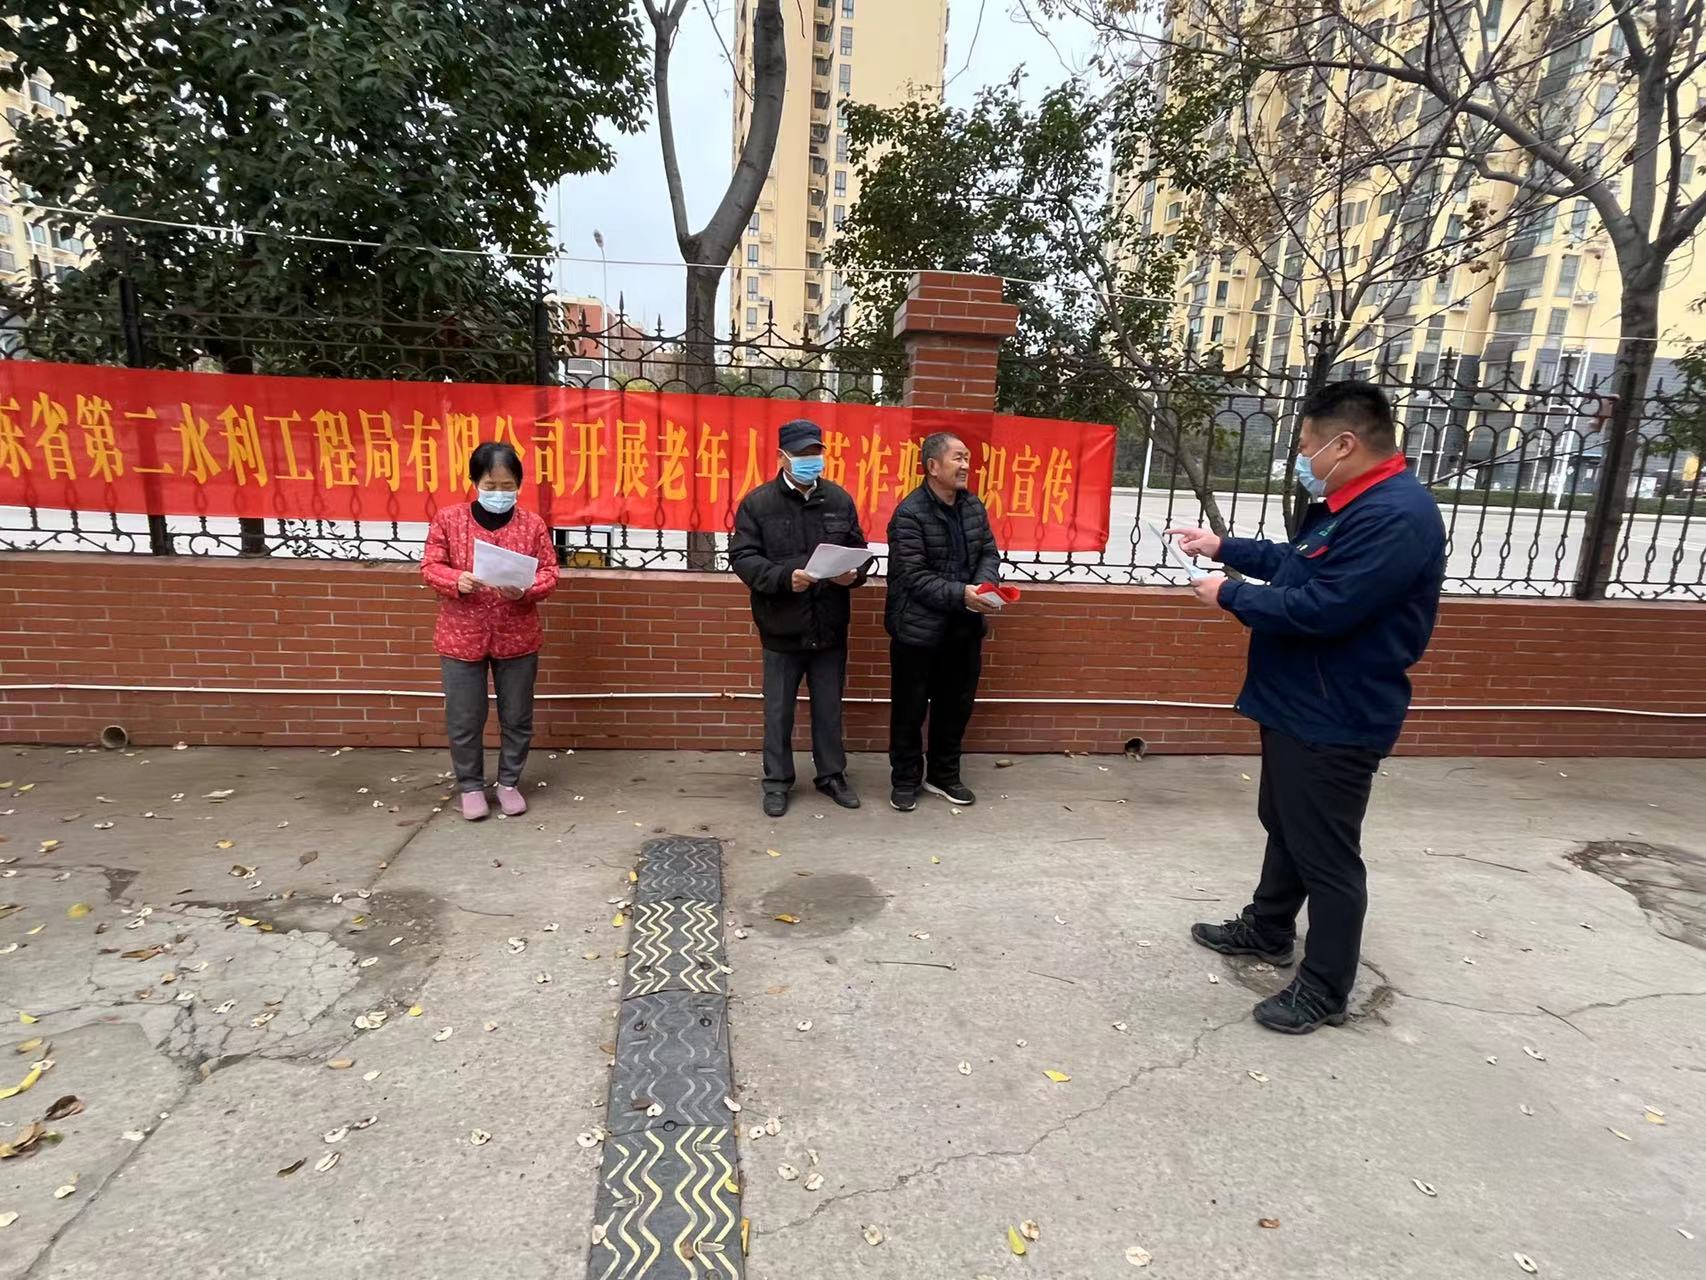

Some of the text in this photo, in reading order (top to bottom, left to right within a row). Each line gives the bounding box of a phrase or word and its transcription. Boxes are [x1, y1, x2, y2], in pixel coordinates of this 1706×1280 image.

[0, 391, 1073, 524] 东省第二水利工程局有限司开展老年人范诈骗识宣传
